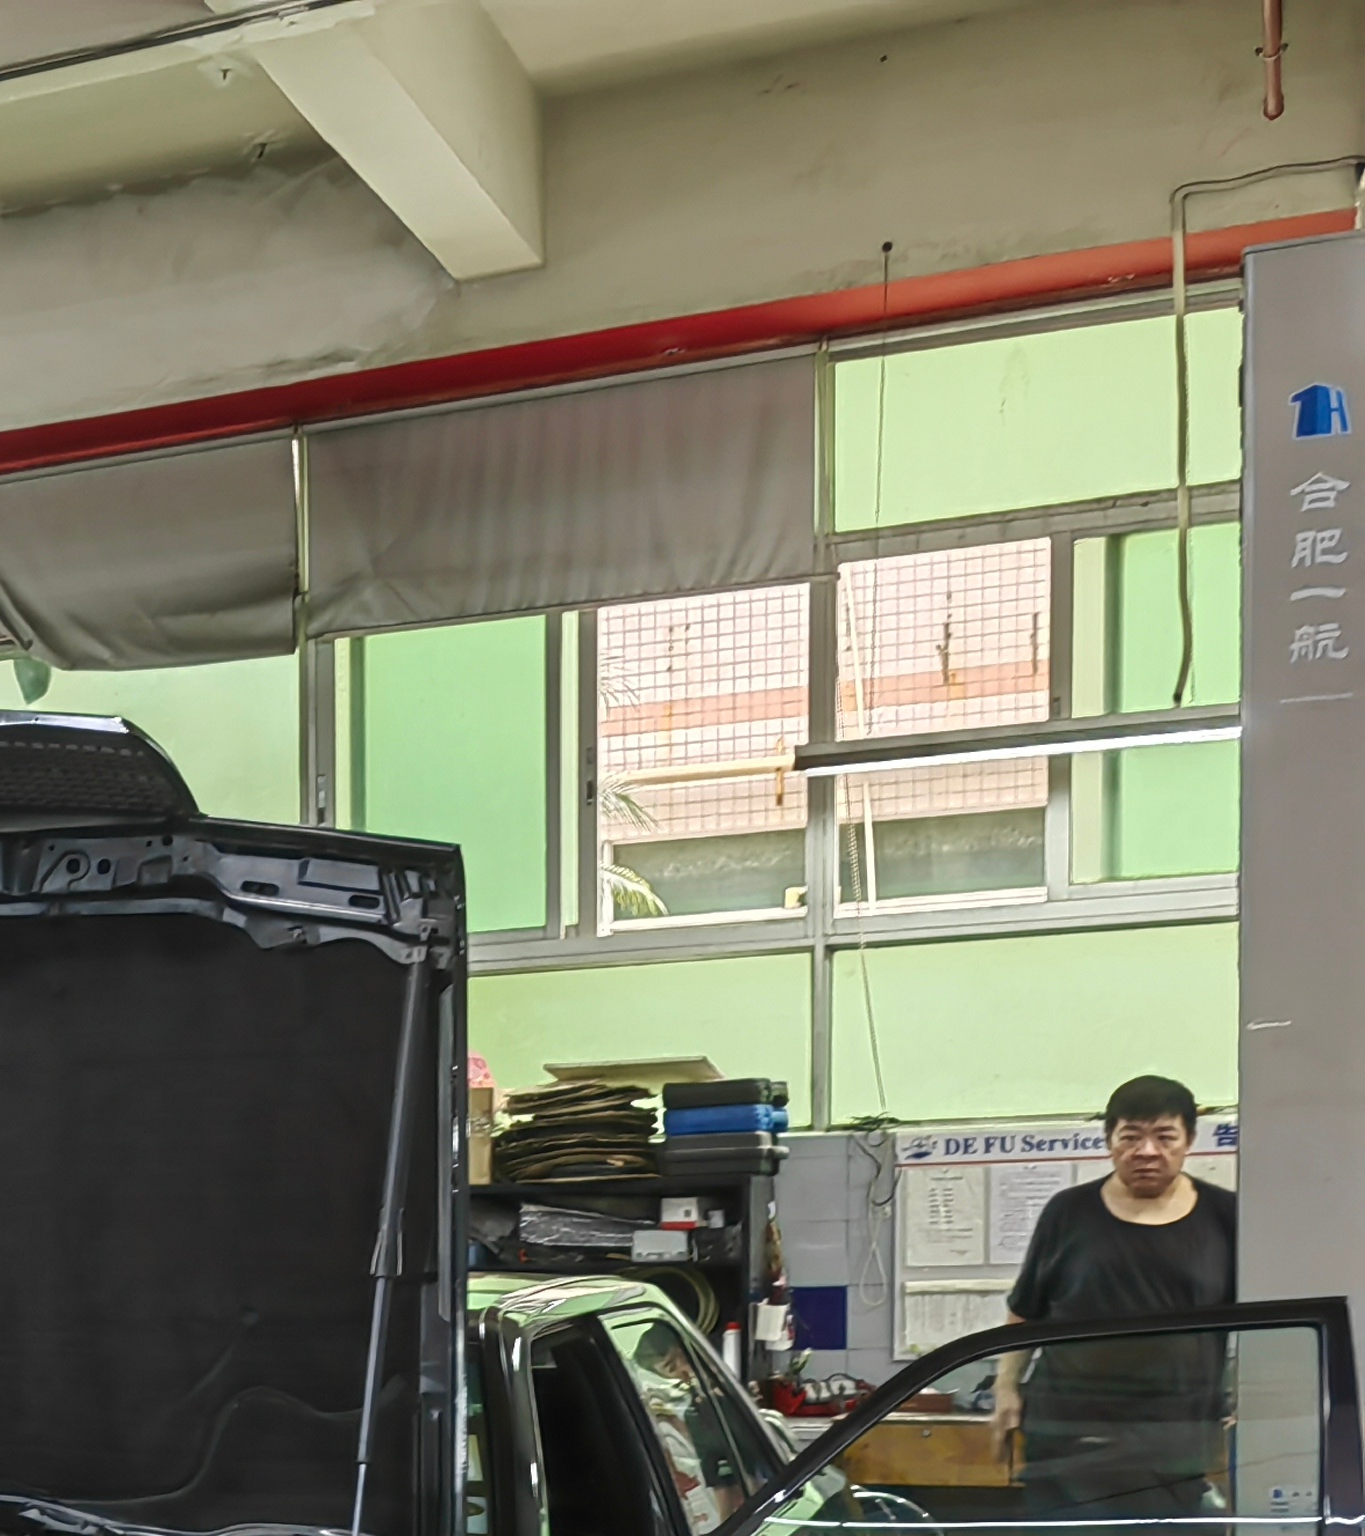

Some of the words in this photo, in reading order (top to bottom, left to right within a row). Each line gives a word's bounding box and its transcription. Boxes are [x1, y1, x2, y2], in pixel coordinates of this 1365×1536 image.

[1289, 471, 1351, 664] 合肥一航
[944, 1137, 979, 1156] DE
[983, 1135, 1017, 1154] FU
[1021, 1132, 1105, 1153] Service
